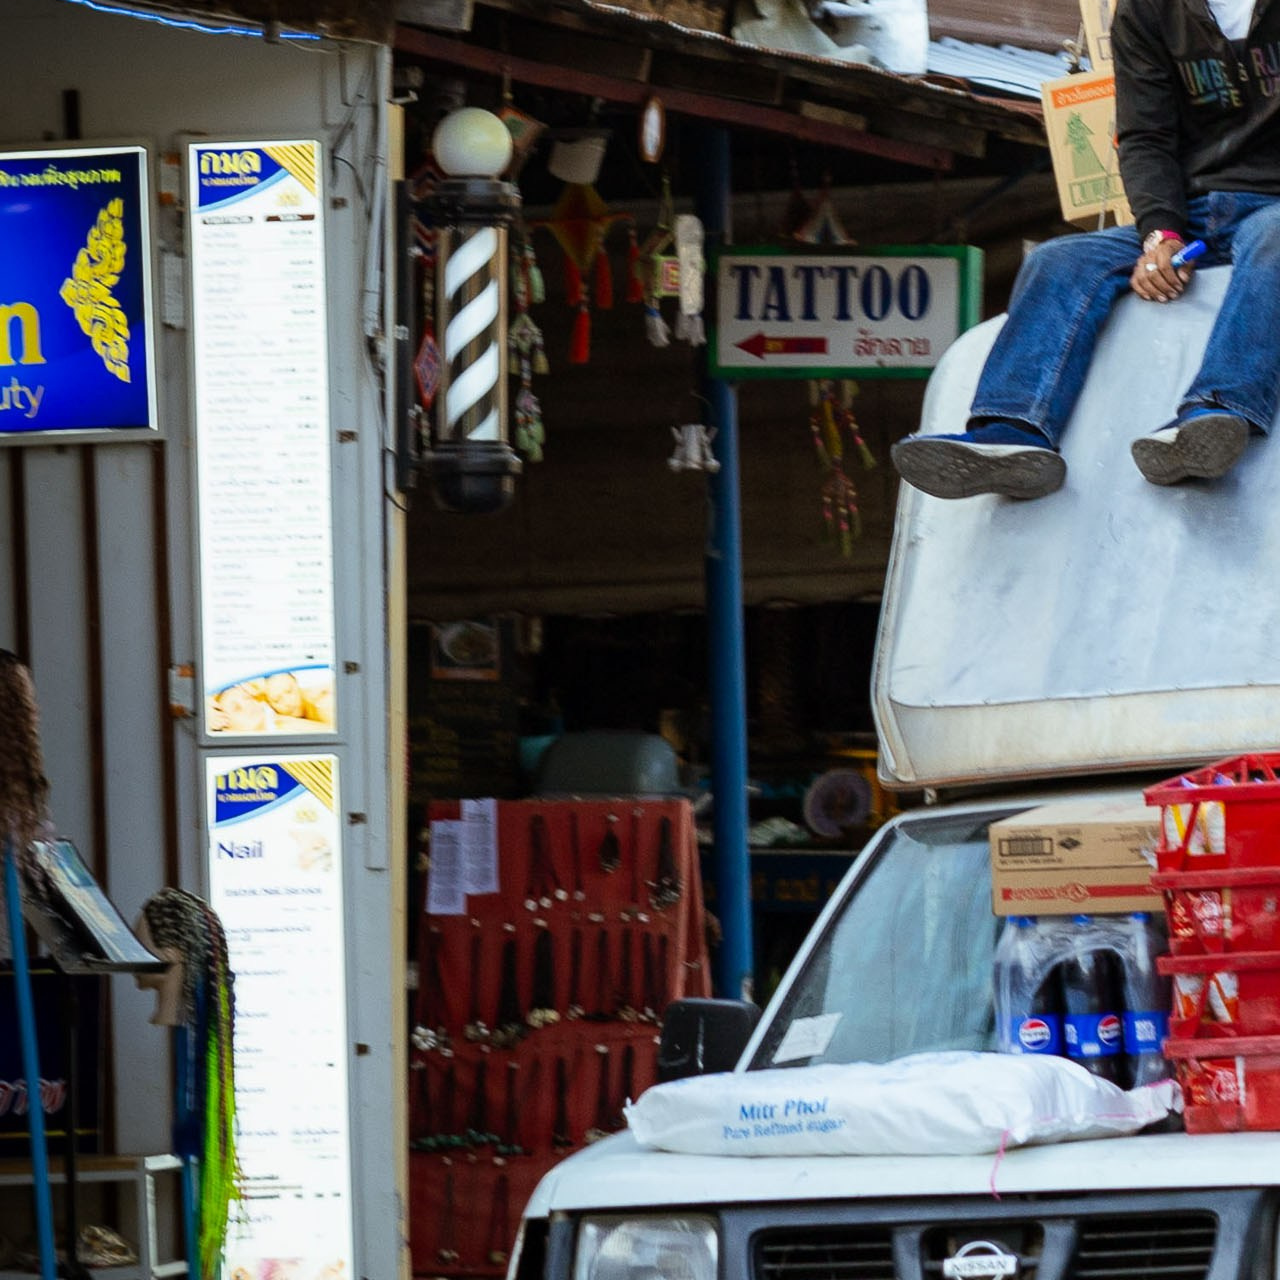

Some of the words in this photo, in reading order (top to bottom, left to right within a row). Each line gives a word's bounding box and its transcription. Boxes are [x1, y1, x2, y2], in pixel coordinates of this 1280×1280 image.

[730, 264, 931, 321] TATTOO
[217, 841, 264, 859] Nail
[739, 1103, 776, 1120] Mitr
[784, 1097, 829, 1117] Phol
[951, 1260, 1008, 1273] NISSAN
